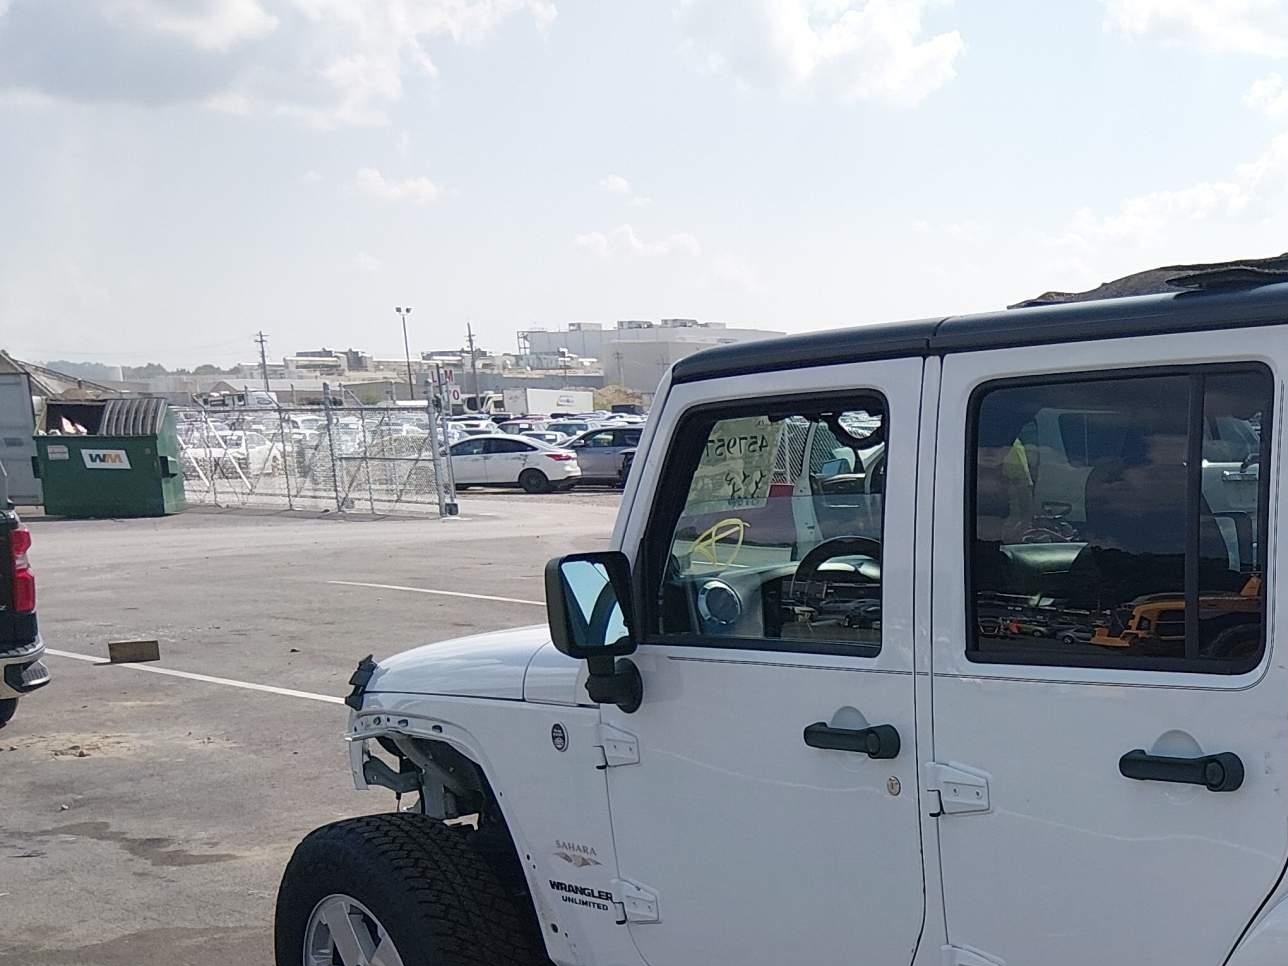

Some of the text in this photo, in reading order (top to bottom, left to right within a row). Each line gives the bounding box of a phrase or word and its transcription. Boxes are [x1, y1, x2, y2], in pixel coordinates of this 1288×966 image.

[88, 453, 123, 464] WM
[554, 839, 598, 857] SAHARA
[548, 879, 614, 903] WRANGLER
[561, 895, 609, 911] UNLIMITED
